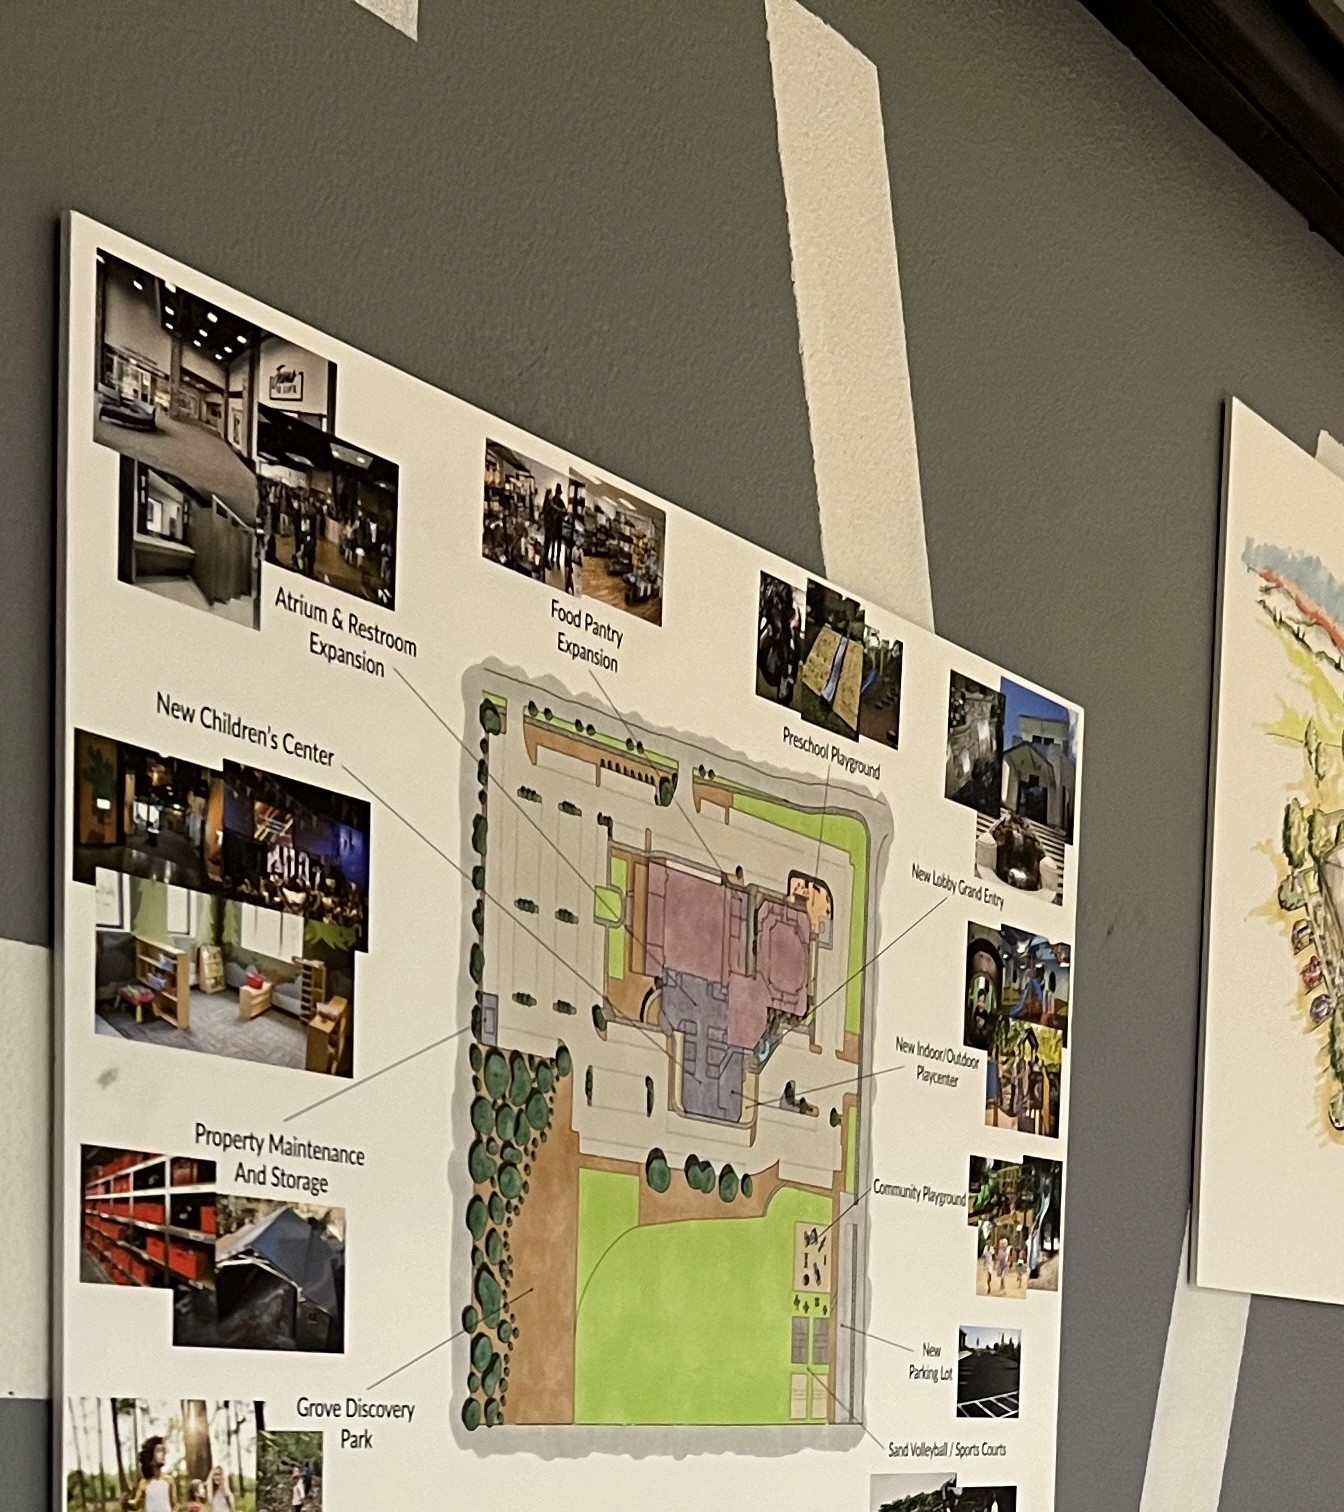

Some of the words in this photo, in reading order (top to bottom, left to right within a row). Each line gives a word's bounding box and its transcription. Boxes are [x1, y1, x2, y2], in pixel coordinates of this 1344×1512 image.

[275, 585, 328, 624] Atrium
[331, 611, 343, 630] &
[348, 615, 417, 657] Restroom
[551, 598, 580, 629] Food
[585, 610, 623, 648] Pantry
[309, 633, 384, 677] Expansion
[557, 631, 618, 672] Expansion
[157, 691, 196, 721] New
[200, 708, 278, 751] Children's
[283, 734, 334, 766] Center
[783, 726, 829, 760] Preschool
[831, 745, 881, 780] Playground
[912, 863, 931, 882] New
[932, 870, 957, 895] Lobby
[958, 879, 982, 901] Grand
[984, 888, 1005, 911] Entry
[896, 1036, 915, 1055] New
[916, 1041, 980, 1069] Indoor/Outdoor
[916, 1065, 959, 1088] Playcenter
[195, 1123, 264, 1156] Property
[269, 1135, 365, 1165] Maintenance
[235, 1163, 267, 1184] And
[271, 1167, 328, 1198] Storage
[873, 1178, 921, 1201] Community
[923, 1185, 967, 1207] Playground
[922, 1342, 941, 1358] New
[909, 1365, 938, 1383] Parking
[940, 1365, 953, 1381] Lot
[297, 1398, 342, 1419] Grove
[345, 1399, 414, 1423] Discovery
[341, 1430, 372, 1449] Park
[888, 1442, 909, 1457] Sand
[911, 1442, 948, 1459] Volleyball
[955, 1443, 979, 1459] Sports
[981, 1442, 1006, 1457] Courts
